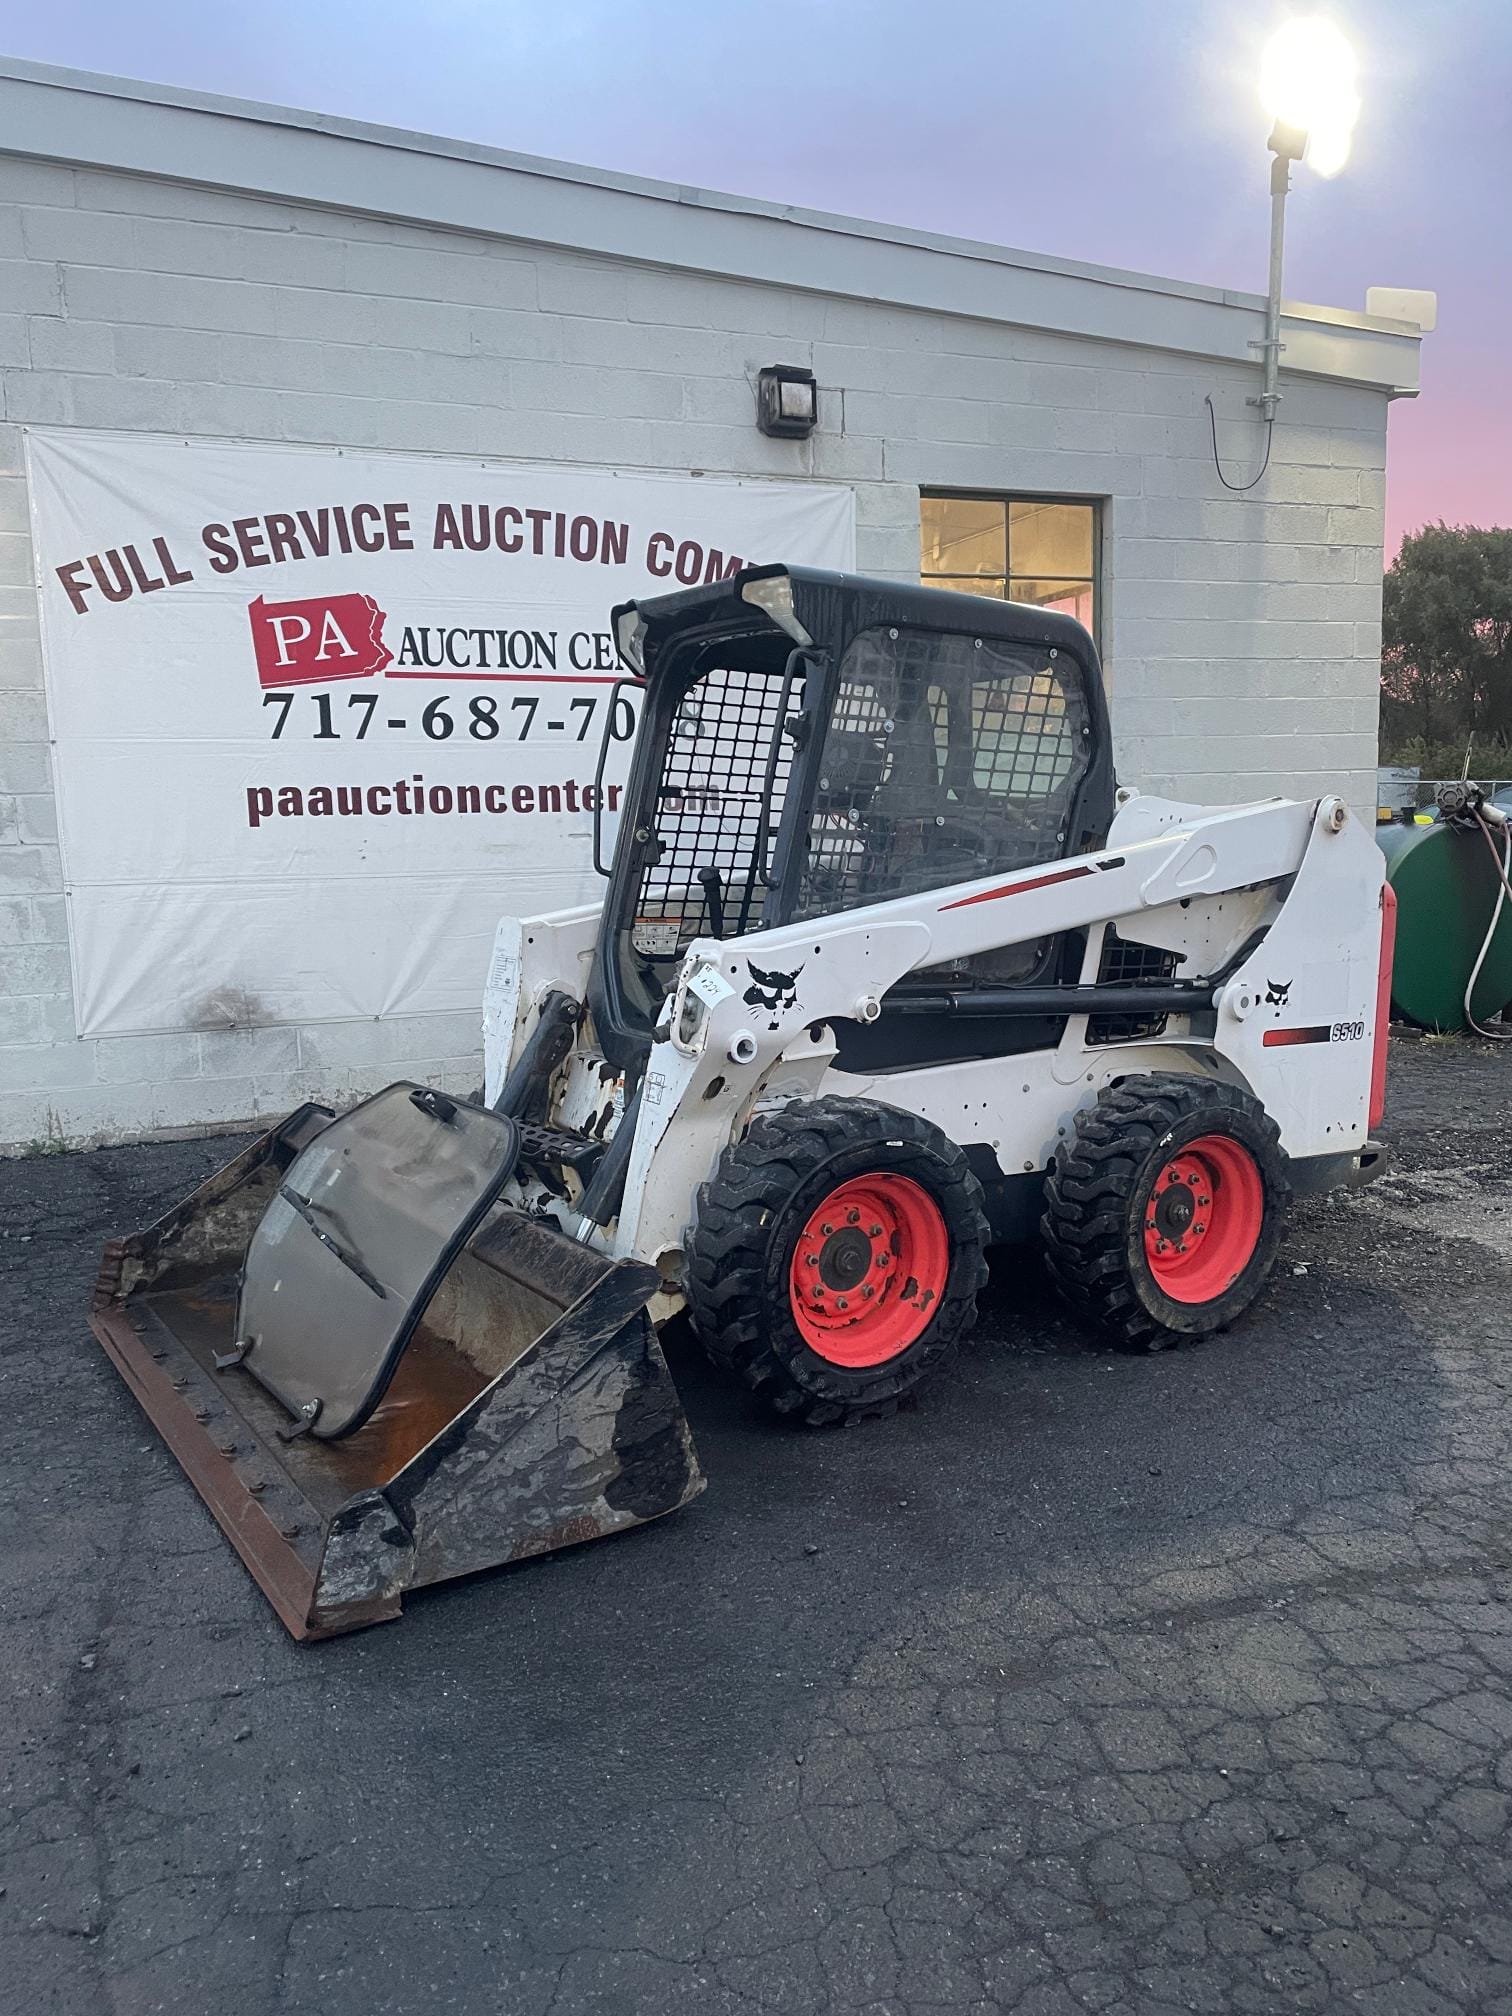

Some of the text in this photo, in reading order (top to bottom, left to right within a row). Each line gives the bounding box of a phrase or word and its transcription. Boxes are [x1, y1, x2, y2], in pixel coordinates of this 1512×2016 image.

[55, 503, 760, 615] FULL SERVICE AUCTION COM
[266, 609, 624, 670] PA AUCTION CE
[262, 692, 706, 742] 717-687-708
[1331, 1021, 1365, 1042] S510
